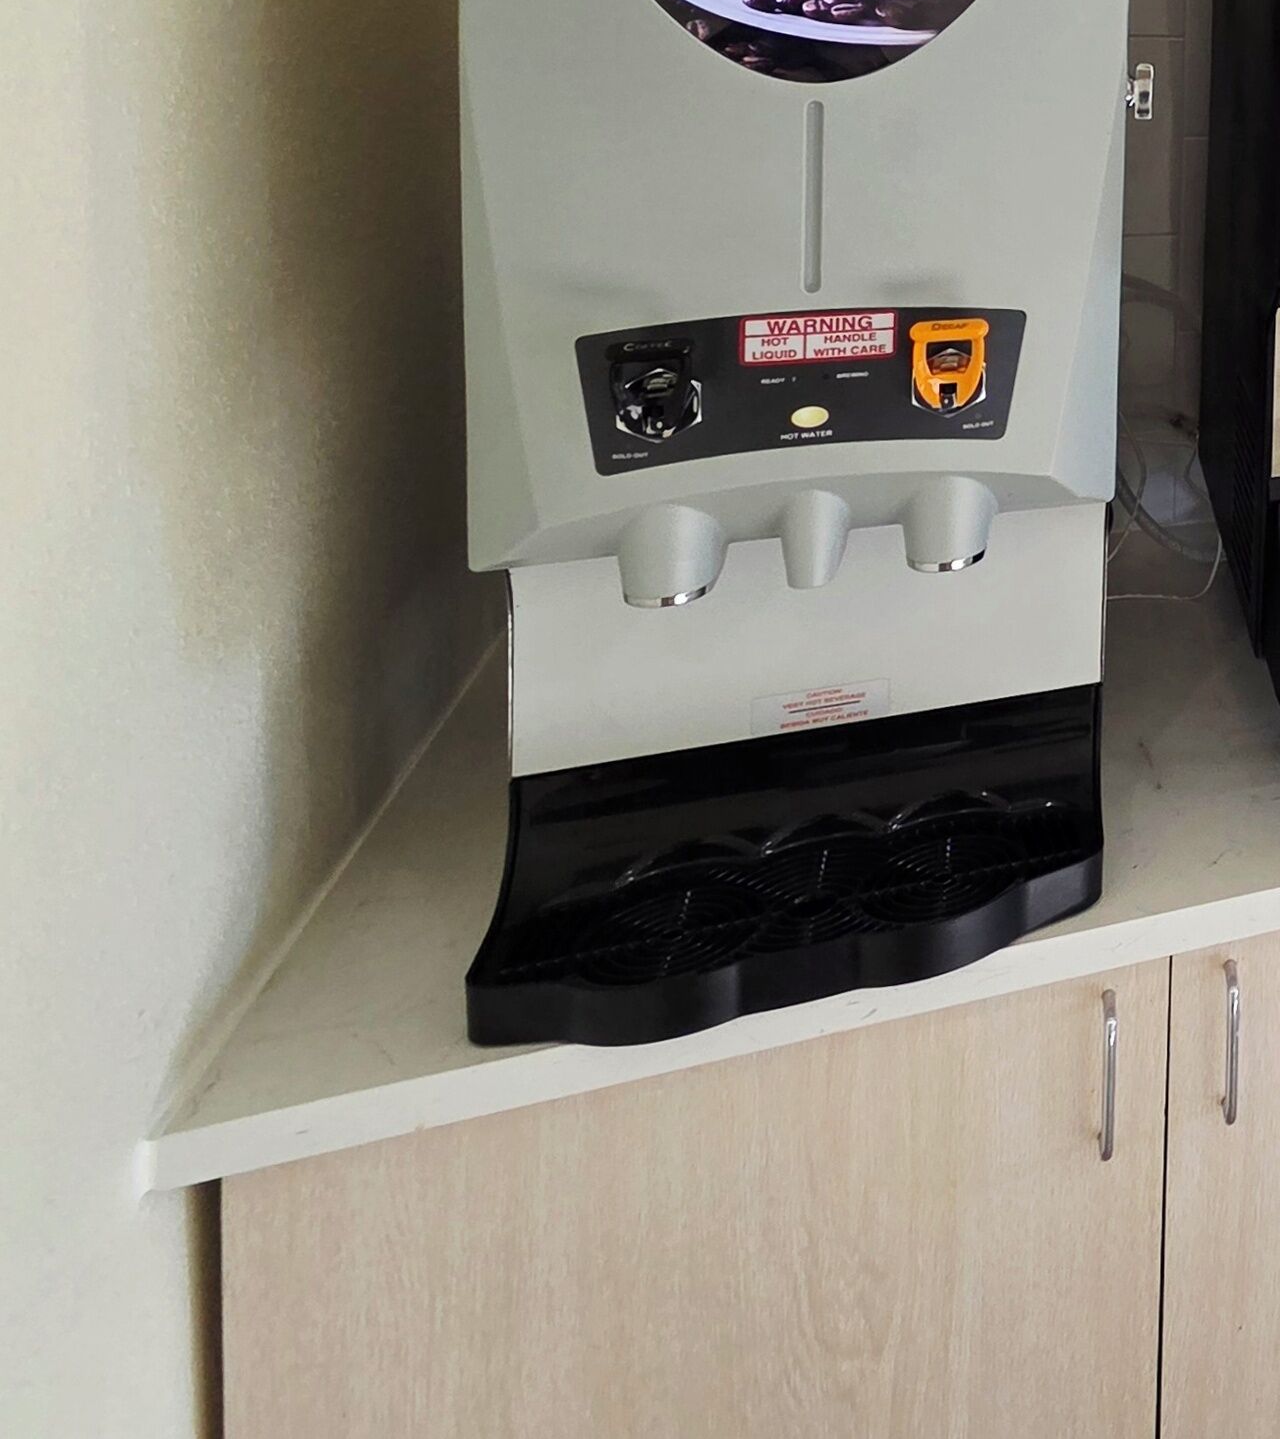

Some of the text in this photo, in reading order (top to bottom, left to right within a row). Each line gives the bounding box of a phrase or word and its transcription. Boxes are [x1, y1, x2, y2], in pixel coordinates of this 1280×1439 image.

[767, 316, 873, 334] WARNING
[761, 337, 789, 347] HOT
[824, 332, 877, 344] HANDLE
[752, 349, 797, 360] LIQUID
[813, 344, 887, 357] WITH CARE
[780, 429, 833, 441] HOT WATER
